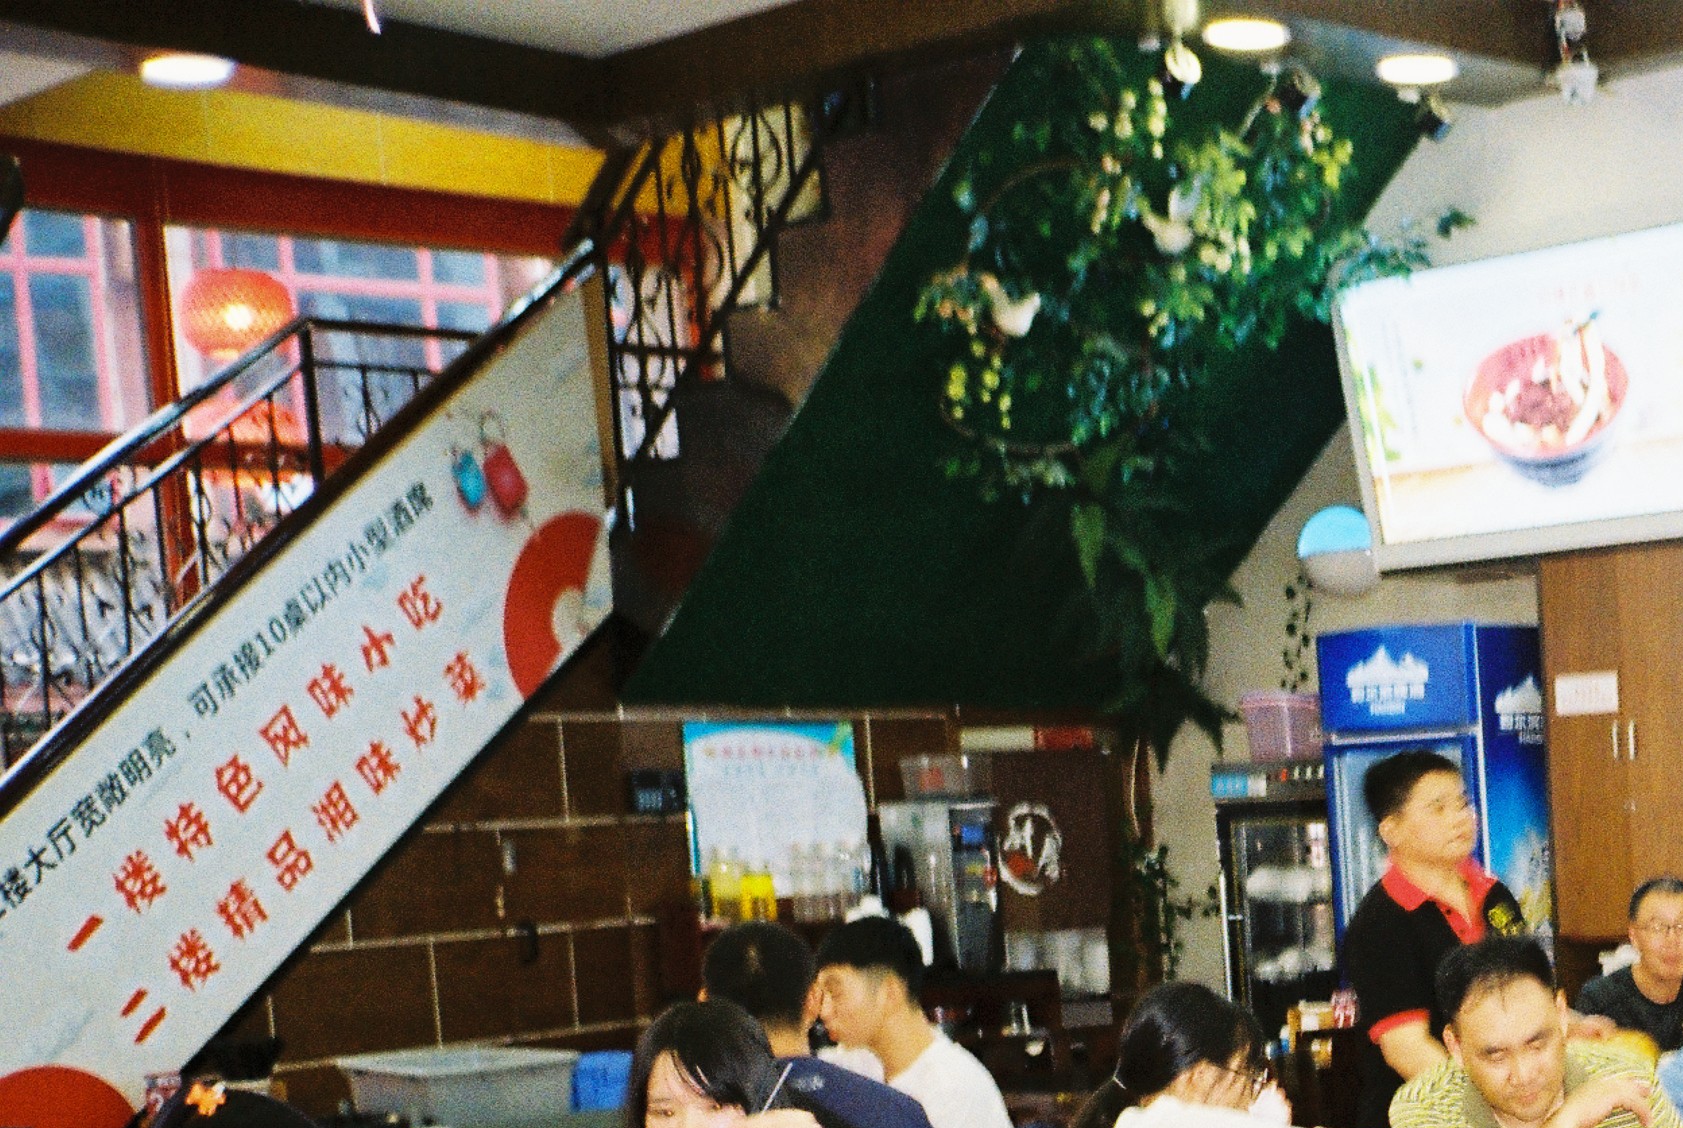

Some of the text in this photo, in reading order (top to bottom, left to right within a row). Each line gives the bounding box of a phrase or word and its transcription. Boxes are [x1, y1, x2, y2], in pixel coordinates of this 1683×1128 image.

[0, 484, 434, 918] 楼大厅宽敞明亮，可承接10桌以内小型酒席
[67, 574, 444, 953] 一楼特色风味小吃
[121, 651, 489, 1045] 二楼精品湘味炒菜
